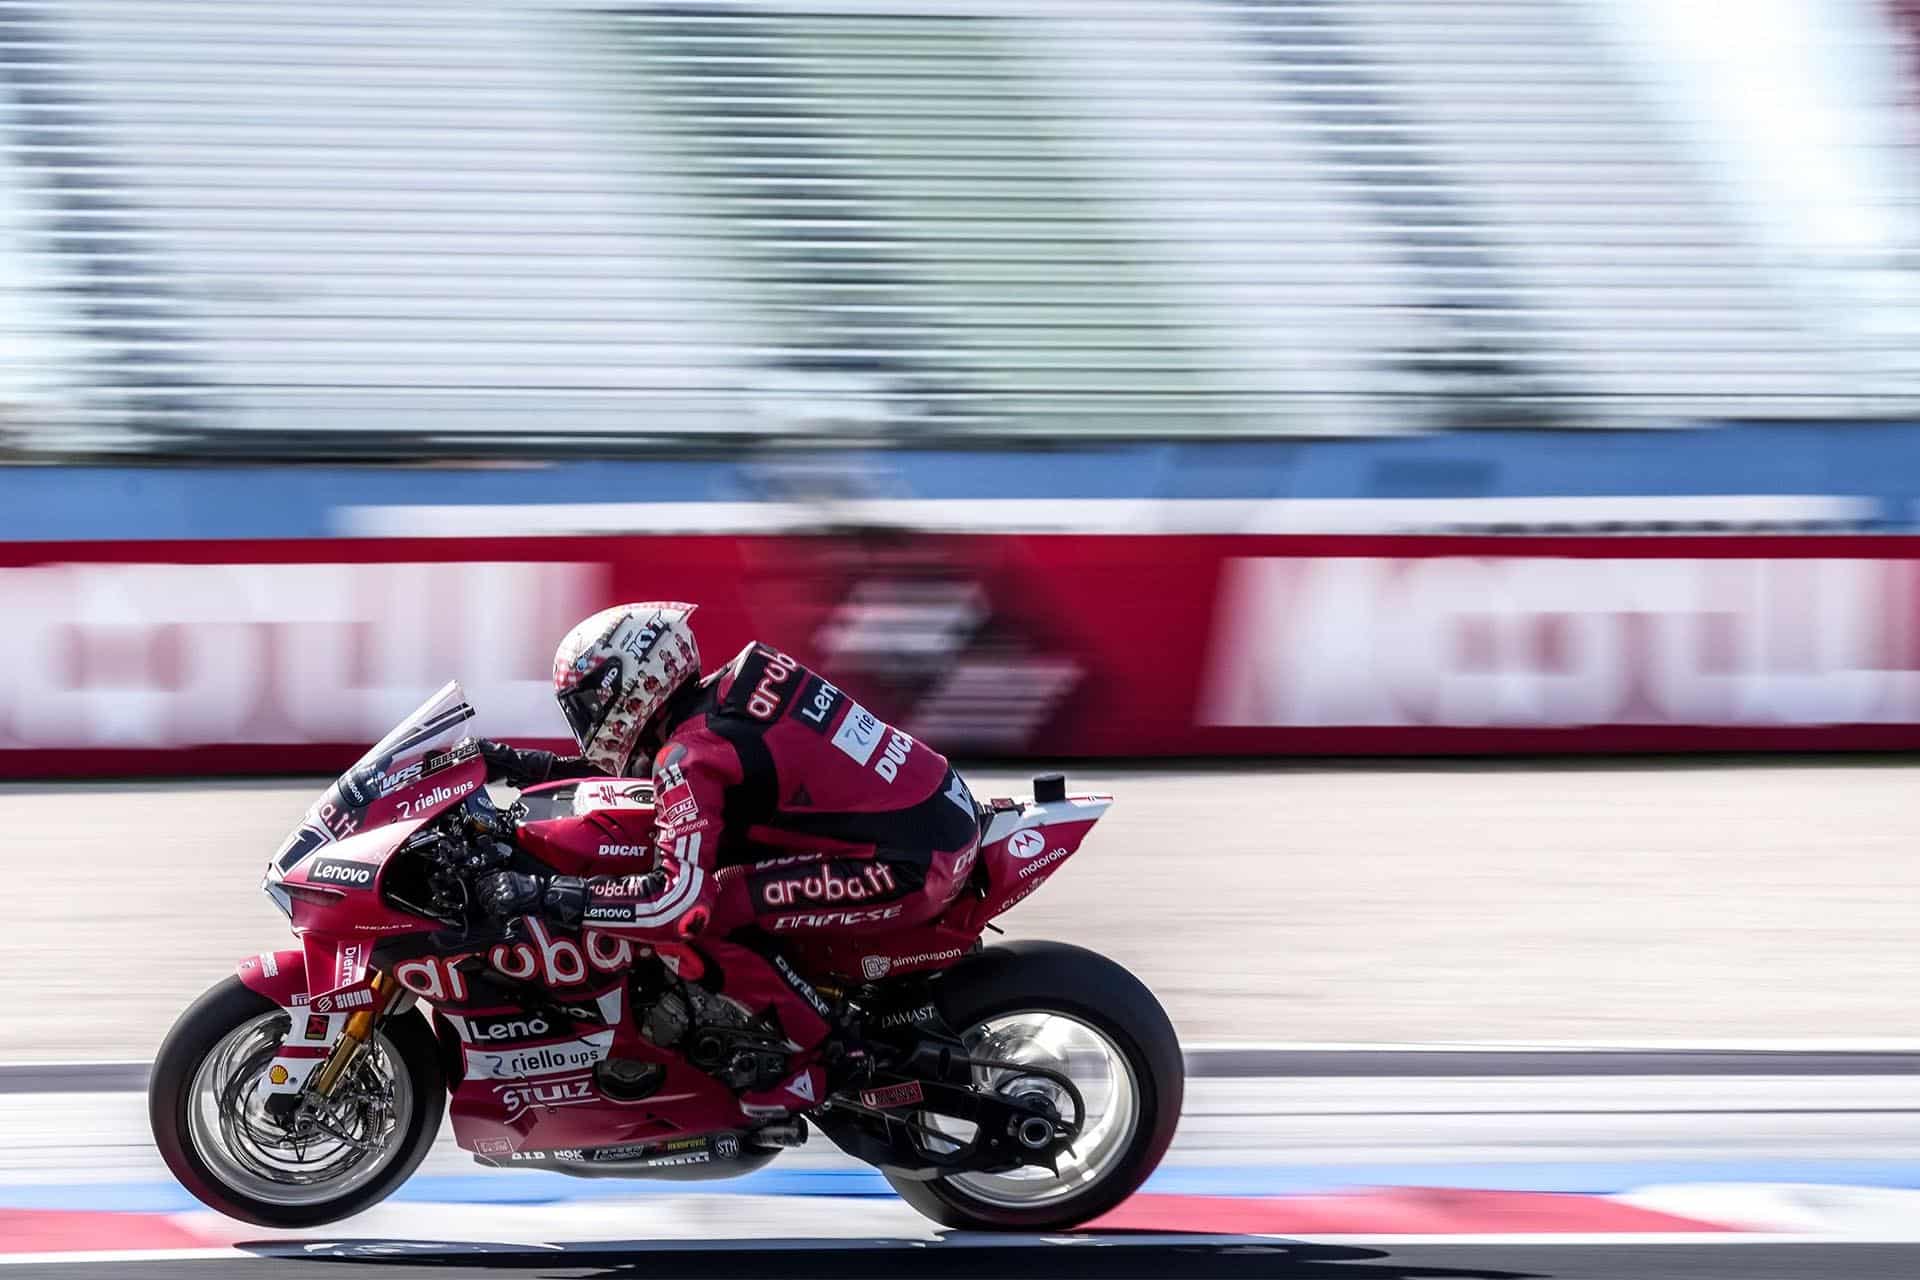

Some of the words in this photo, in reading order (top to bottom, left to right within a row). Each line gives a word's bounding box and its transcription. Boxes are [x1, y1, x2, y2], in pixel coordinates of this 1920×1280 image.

[626, 610, 665, 658] KYT
[414, 786, 451, 813] riello
[453, 781, 474, 794] ups
[313, 860, 370, 883] Lenovo
[1018, 847, 1068, 879] motorola
[763, 863, 896, 904] aruba.it
[584, 906, 632, 919] Lenovo
[774, 904, 903, 929] DAINESE
[891, 947, 962, 967] simyousoon
[511, 1053, 565, 1073] riello
[569, 1049, 599, 1064] ups
[502, 1082, 592, 1111] STULZ
